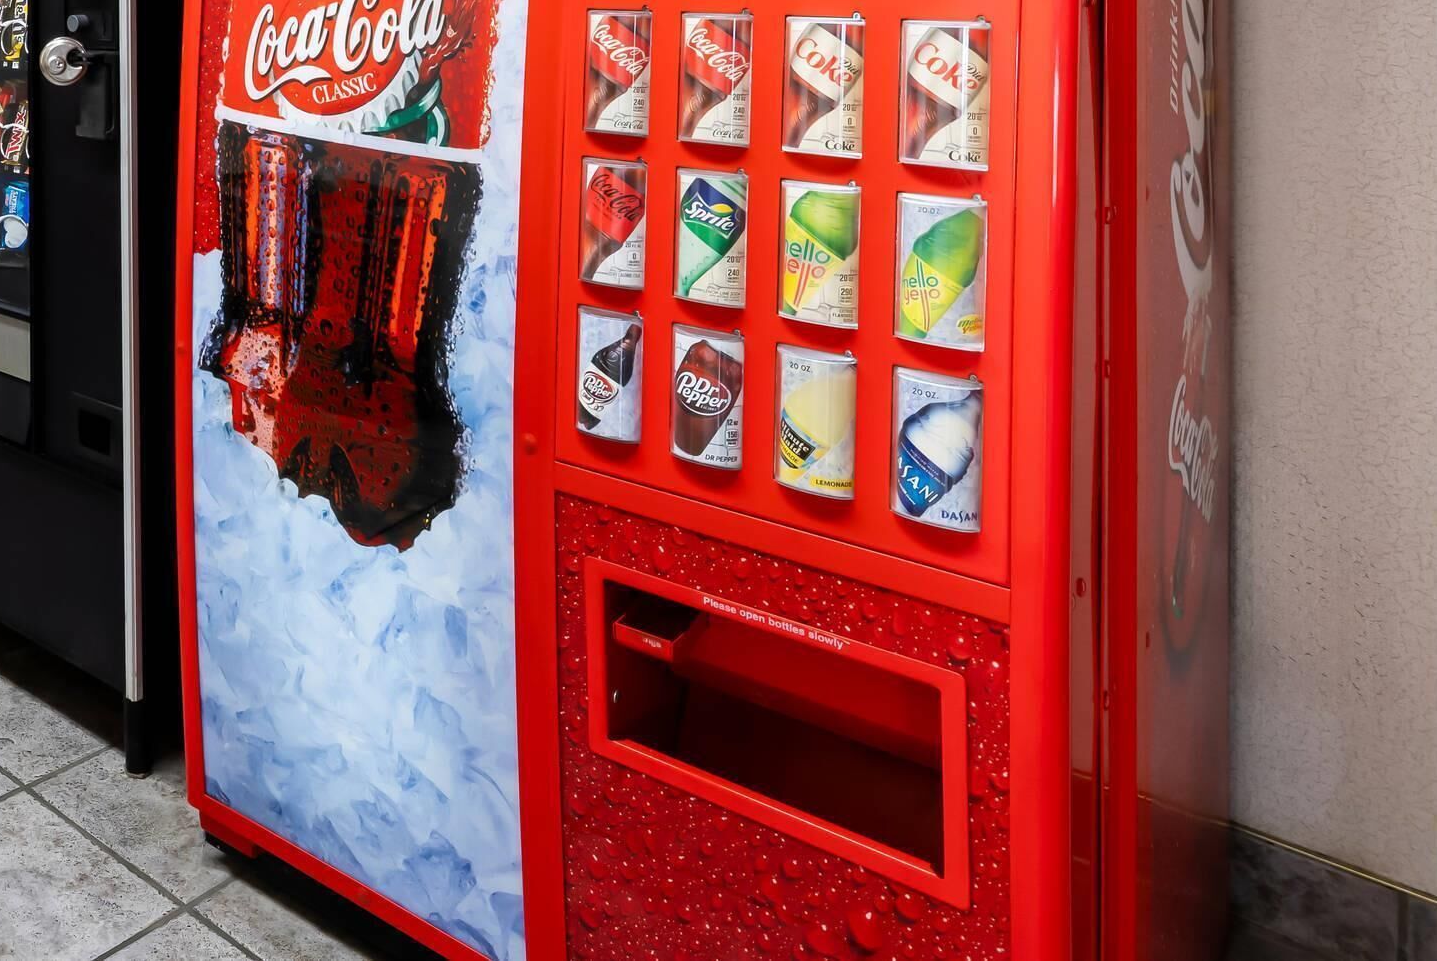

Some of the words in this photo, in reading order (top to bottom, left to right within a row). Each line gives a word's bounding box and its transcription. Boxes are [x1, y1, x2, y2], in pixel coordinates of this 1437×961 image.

[795, 38, 855, 87] Coke
[840, 56, 860, 75] Diet
[914, 42, 979, 90] Coke
[312, 72, 377, 104] CLASSIC
[633, 98, 645, 106] 240
[842, 103, 851, 112] 20
[733, 106, 745, 114] 240
[967, 112, 976, 121] 20
[824, 139, 855, 151] Coke
[948, 150, 981, 162] Coke
[684, 201, 735, 231] Sprite
[727, 269, 740, 277] 240
[789, 361, 799, 371] 20
[584, 375, 613, 397] Pepper
[593, 378, 608, 390] Dr
[676, 371, 729, 408] Pepper
[693, 377, 720, 396] Dr
[912, 387, 923, 396] 20
[715, 455, 738, 463] PEPPER
[815, 479, 852, 488] LEMONADE
[941, 510, 978, 523] DASAN
[702, 596, 737, 615] Please
[739, 609, 765, 626] open
[768, 617, 805, 637] bottles
[808, 629, 844, 650] slowly
